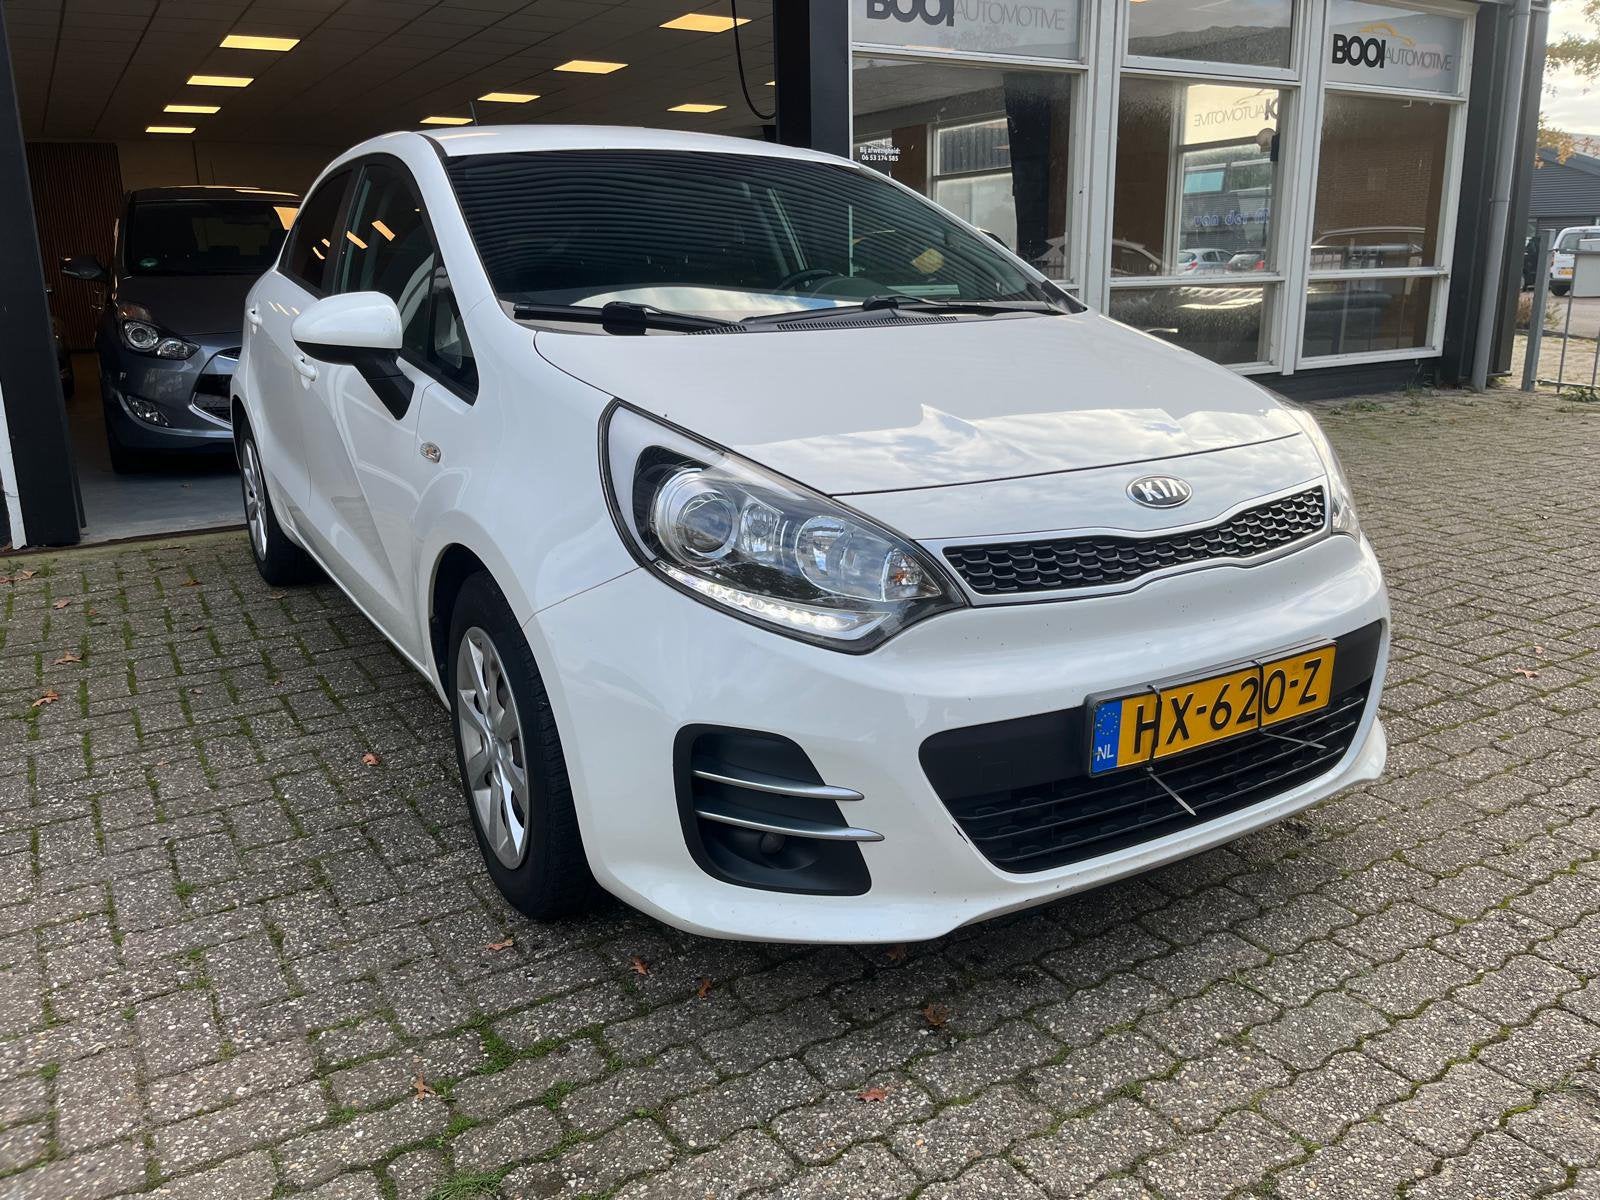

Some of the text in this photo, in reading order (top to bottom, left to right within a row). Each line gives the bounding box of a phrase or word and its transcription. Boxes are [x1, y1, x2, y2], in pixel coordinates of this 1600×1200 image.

[867, 0, 1066, 30] BOOI AUTOMOTIVE
[1332, 33, 1453, 71] BOOI AUTOMOTIVE
[1135, 479, 1188, 501] KIA
[1096, 657, 1322, 761] NL HX-620-Z
